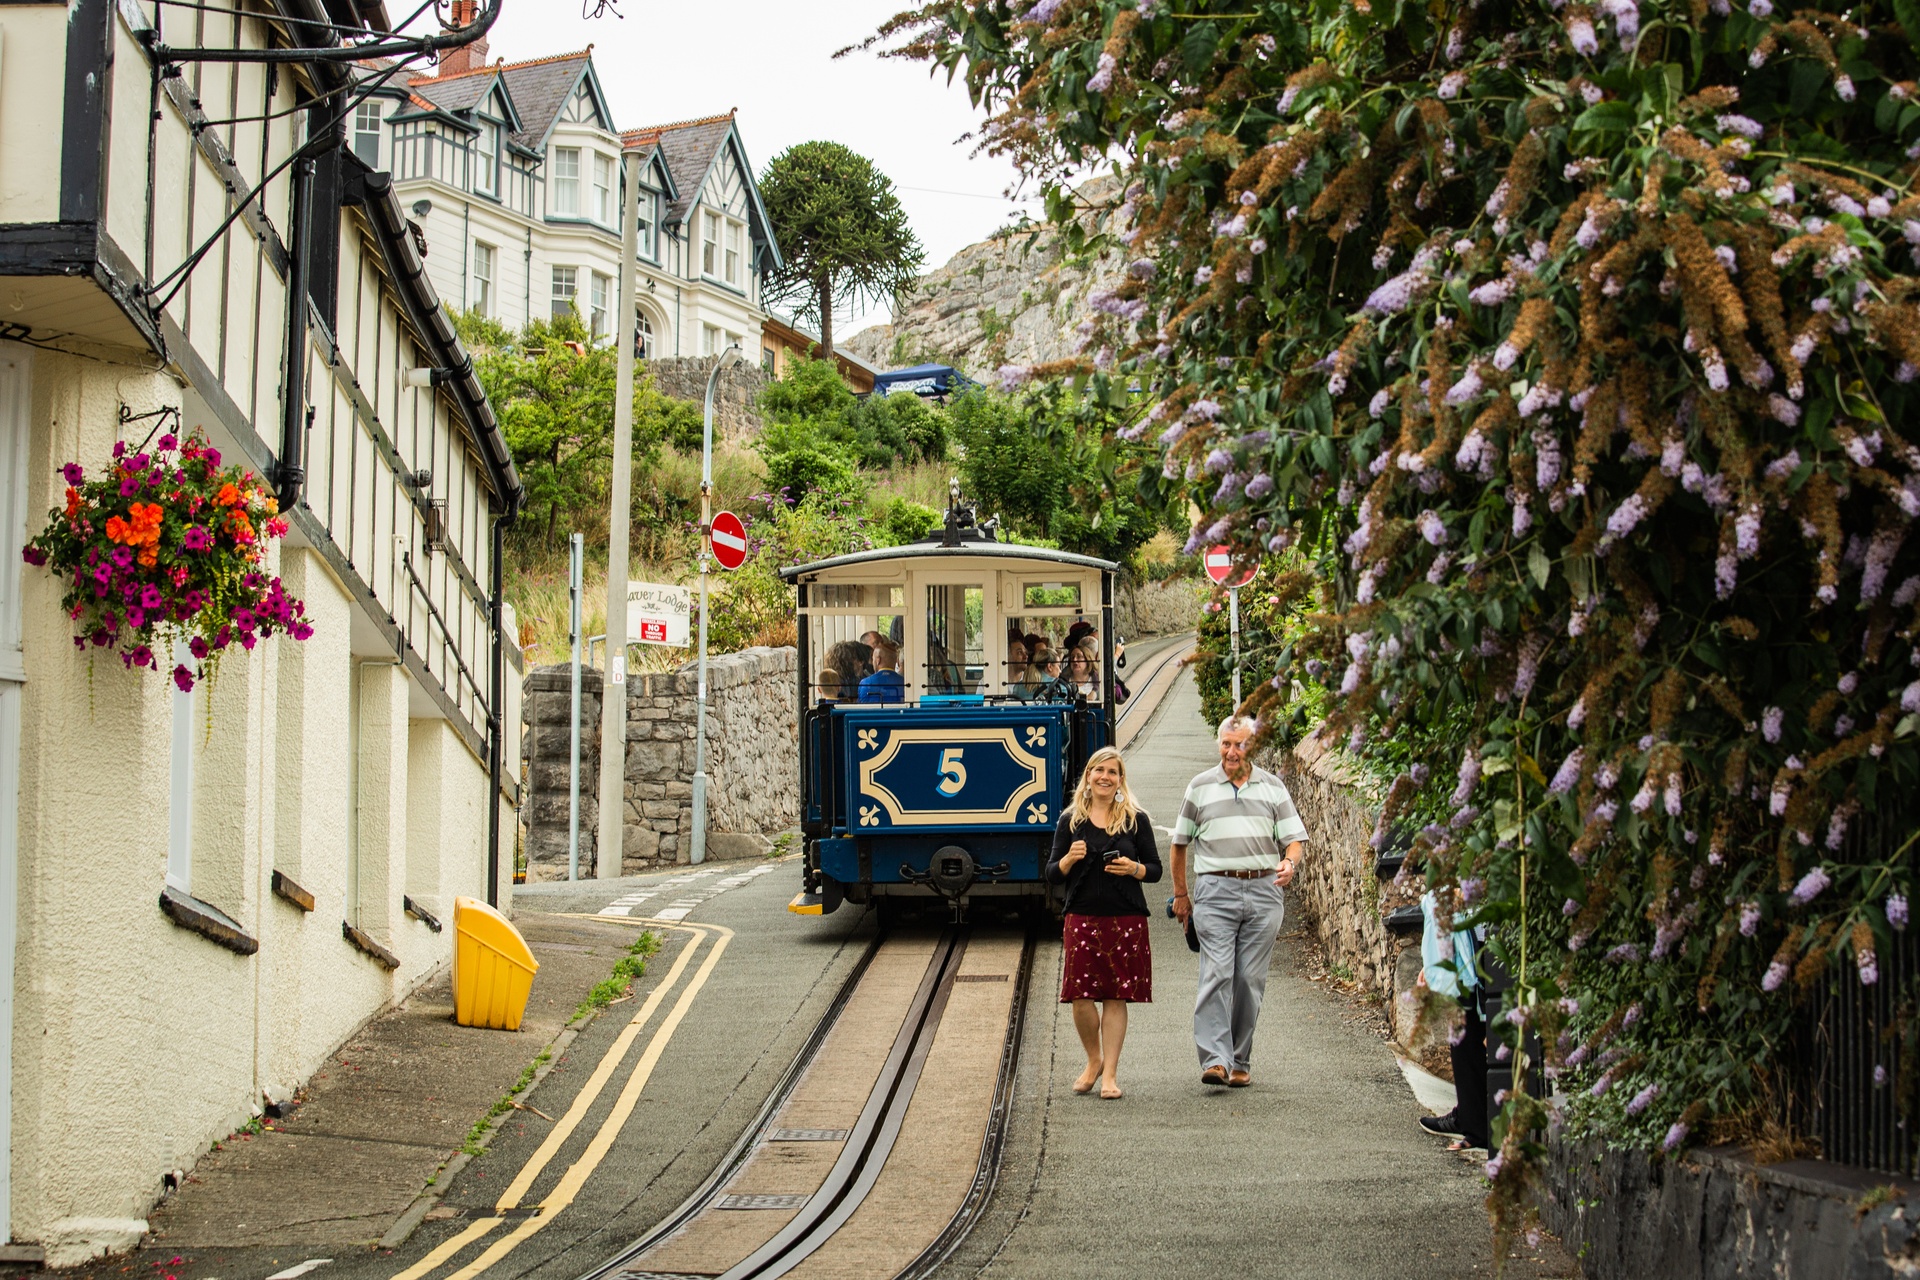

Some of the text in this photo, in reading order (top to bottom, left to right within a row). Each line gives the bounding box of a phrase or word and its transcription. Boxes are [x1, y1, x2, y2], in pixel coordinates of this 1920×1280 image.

[657, 590, 688, 613] Lodge
[648, 624, 660, 632] NO
[615, 673, 622, 681] D
[937, 748, 967, 797] 5
